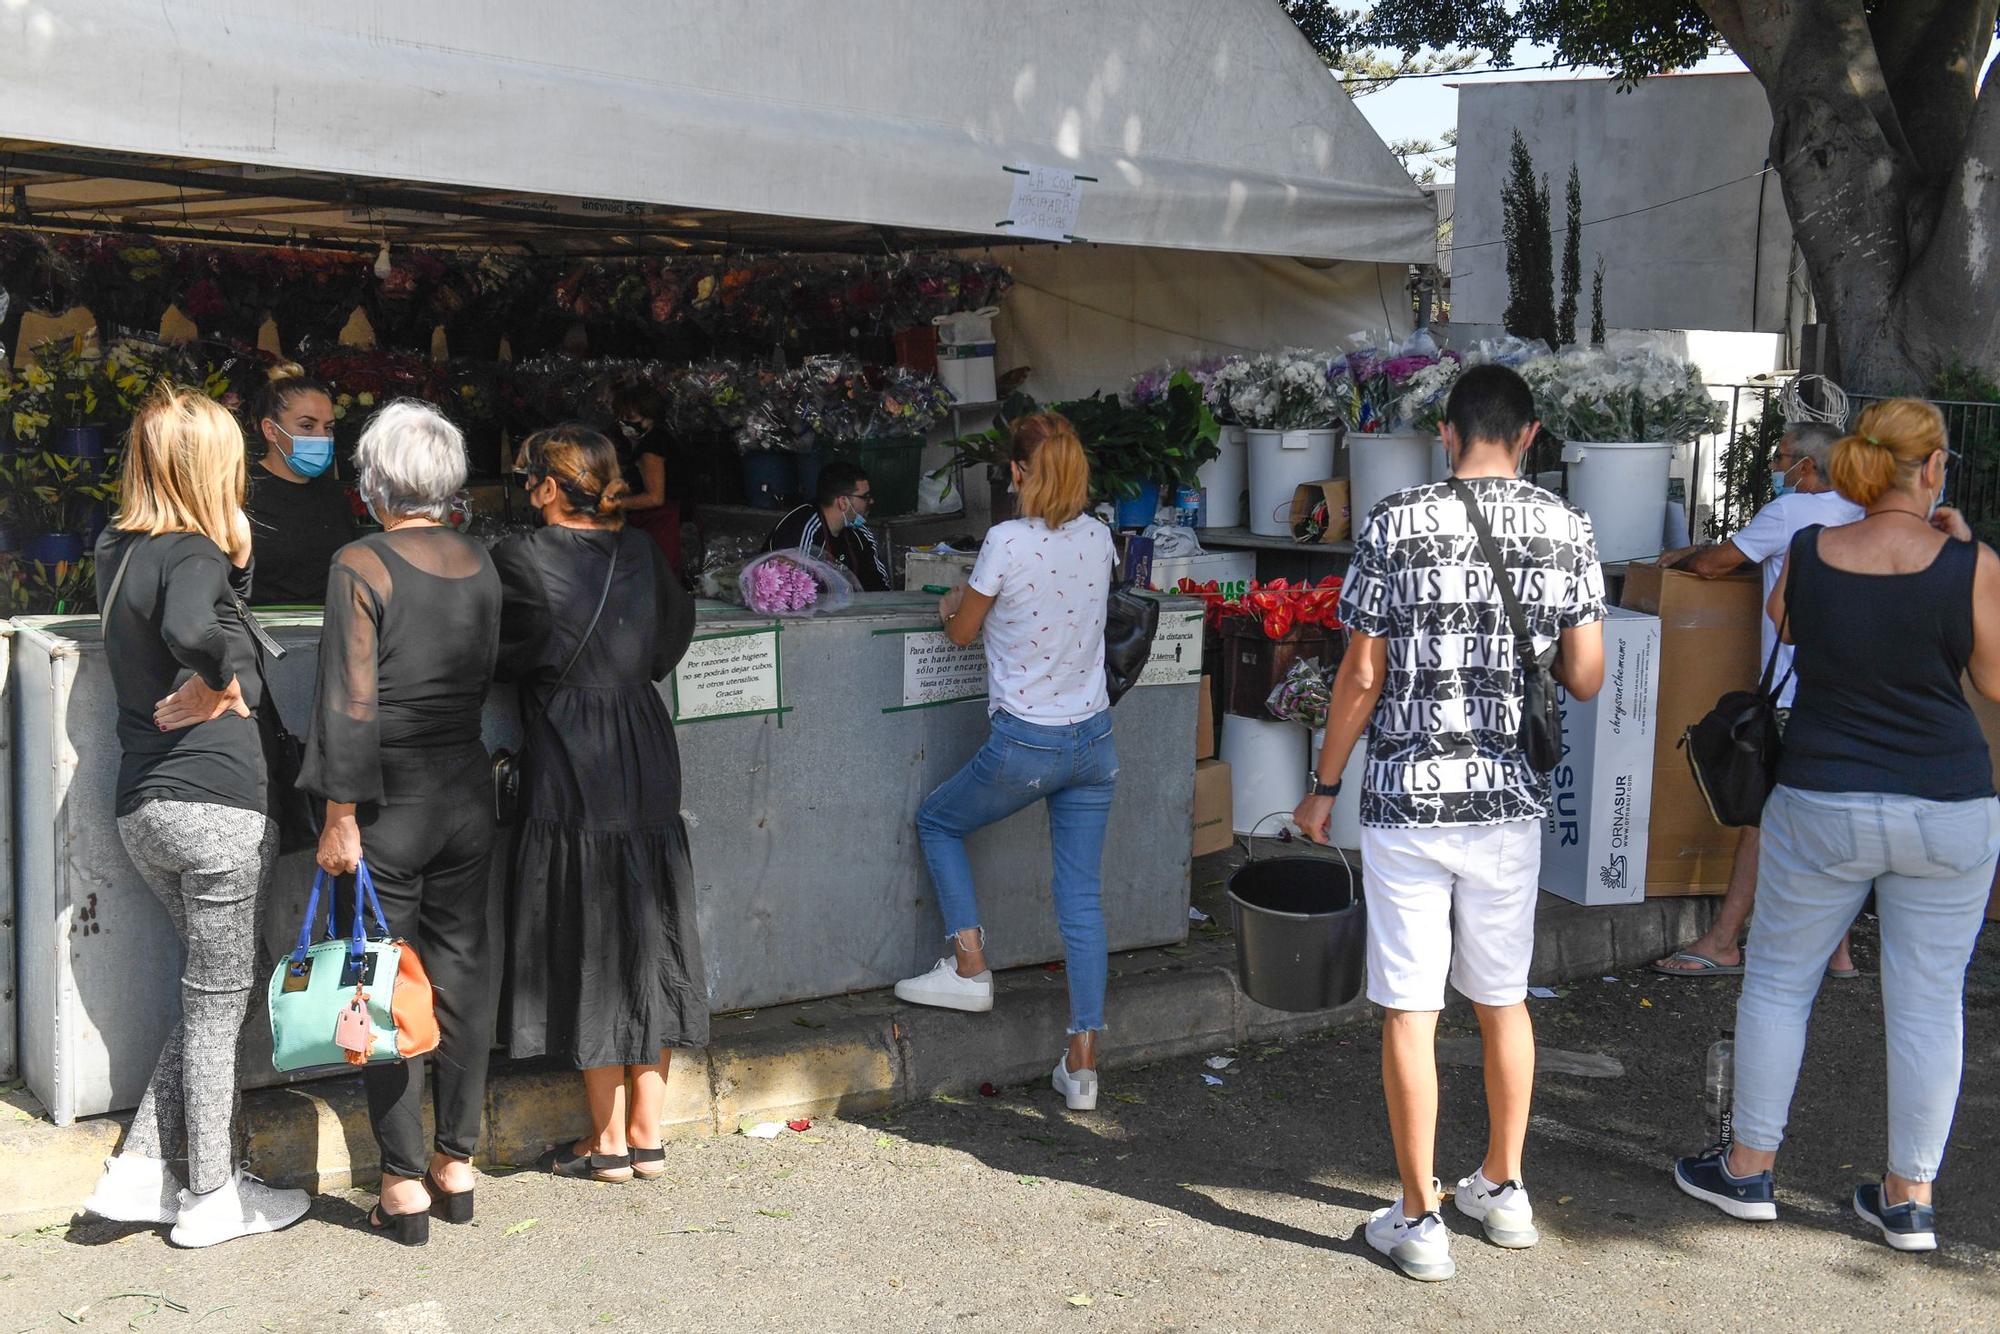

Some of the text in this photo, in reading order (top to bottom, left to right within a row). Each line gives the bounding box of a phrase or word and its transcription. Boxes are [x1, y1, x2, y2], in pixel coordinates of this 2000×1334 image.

[1466, 505, 1546, 535] VRIS
[1166, 632, 1193, 641] distancia
[910, 647, 925, 655] Para
[926, 646, 934, 654] el
[687, 652, 768, 669] Por razones de higiene
[931, 654, 957, 664] harán
[703, 668, 730, 679] podrán
[731, 665, 750, 674] dejar
[916, 662, 988, 675] sólo por encargo
[706, 681, 724, 689] otros
[920, 680, 937, 688] Hasta
[938, 678, 945, 686] el
[961, 676, 983, 684] octubre
[1609, 638, 1627, 734] chrysanthemums
[715, 689, 744, 698] Gracias
[1612, 776, 1627, 848] ORNASUR
[1623, 774, 1633, 848] www.ornasur.com
